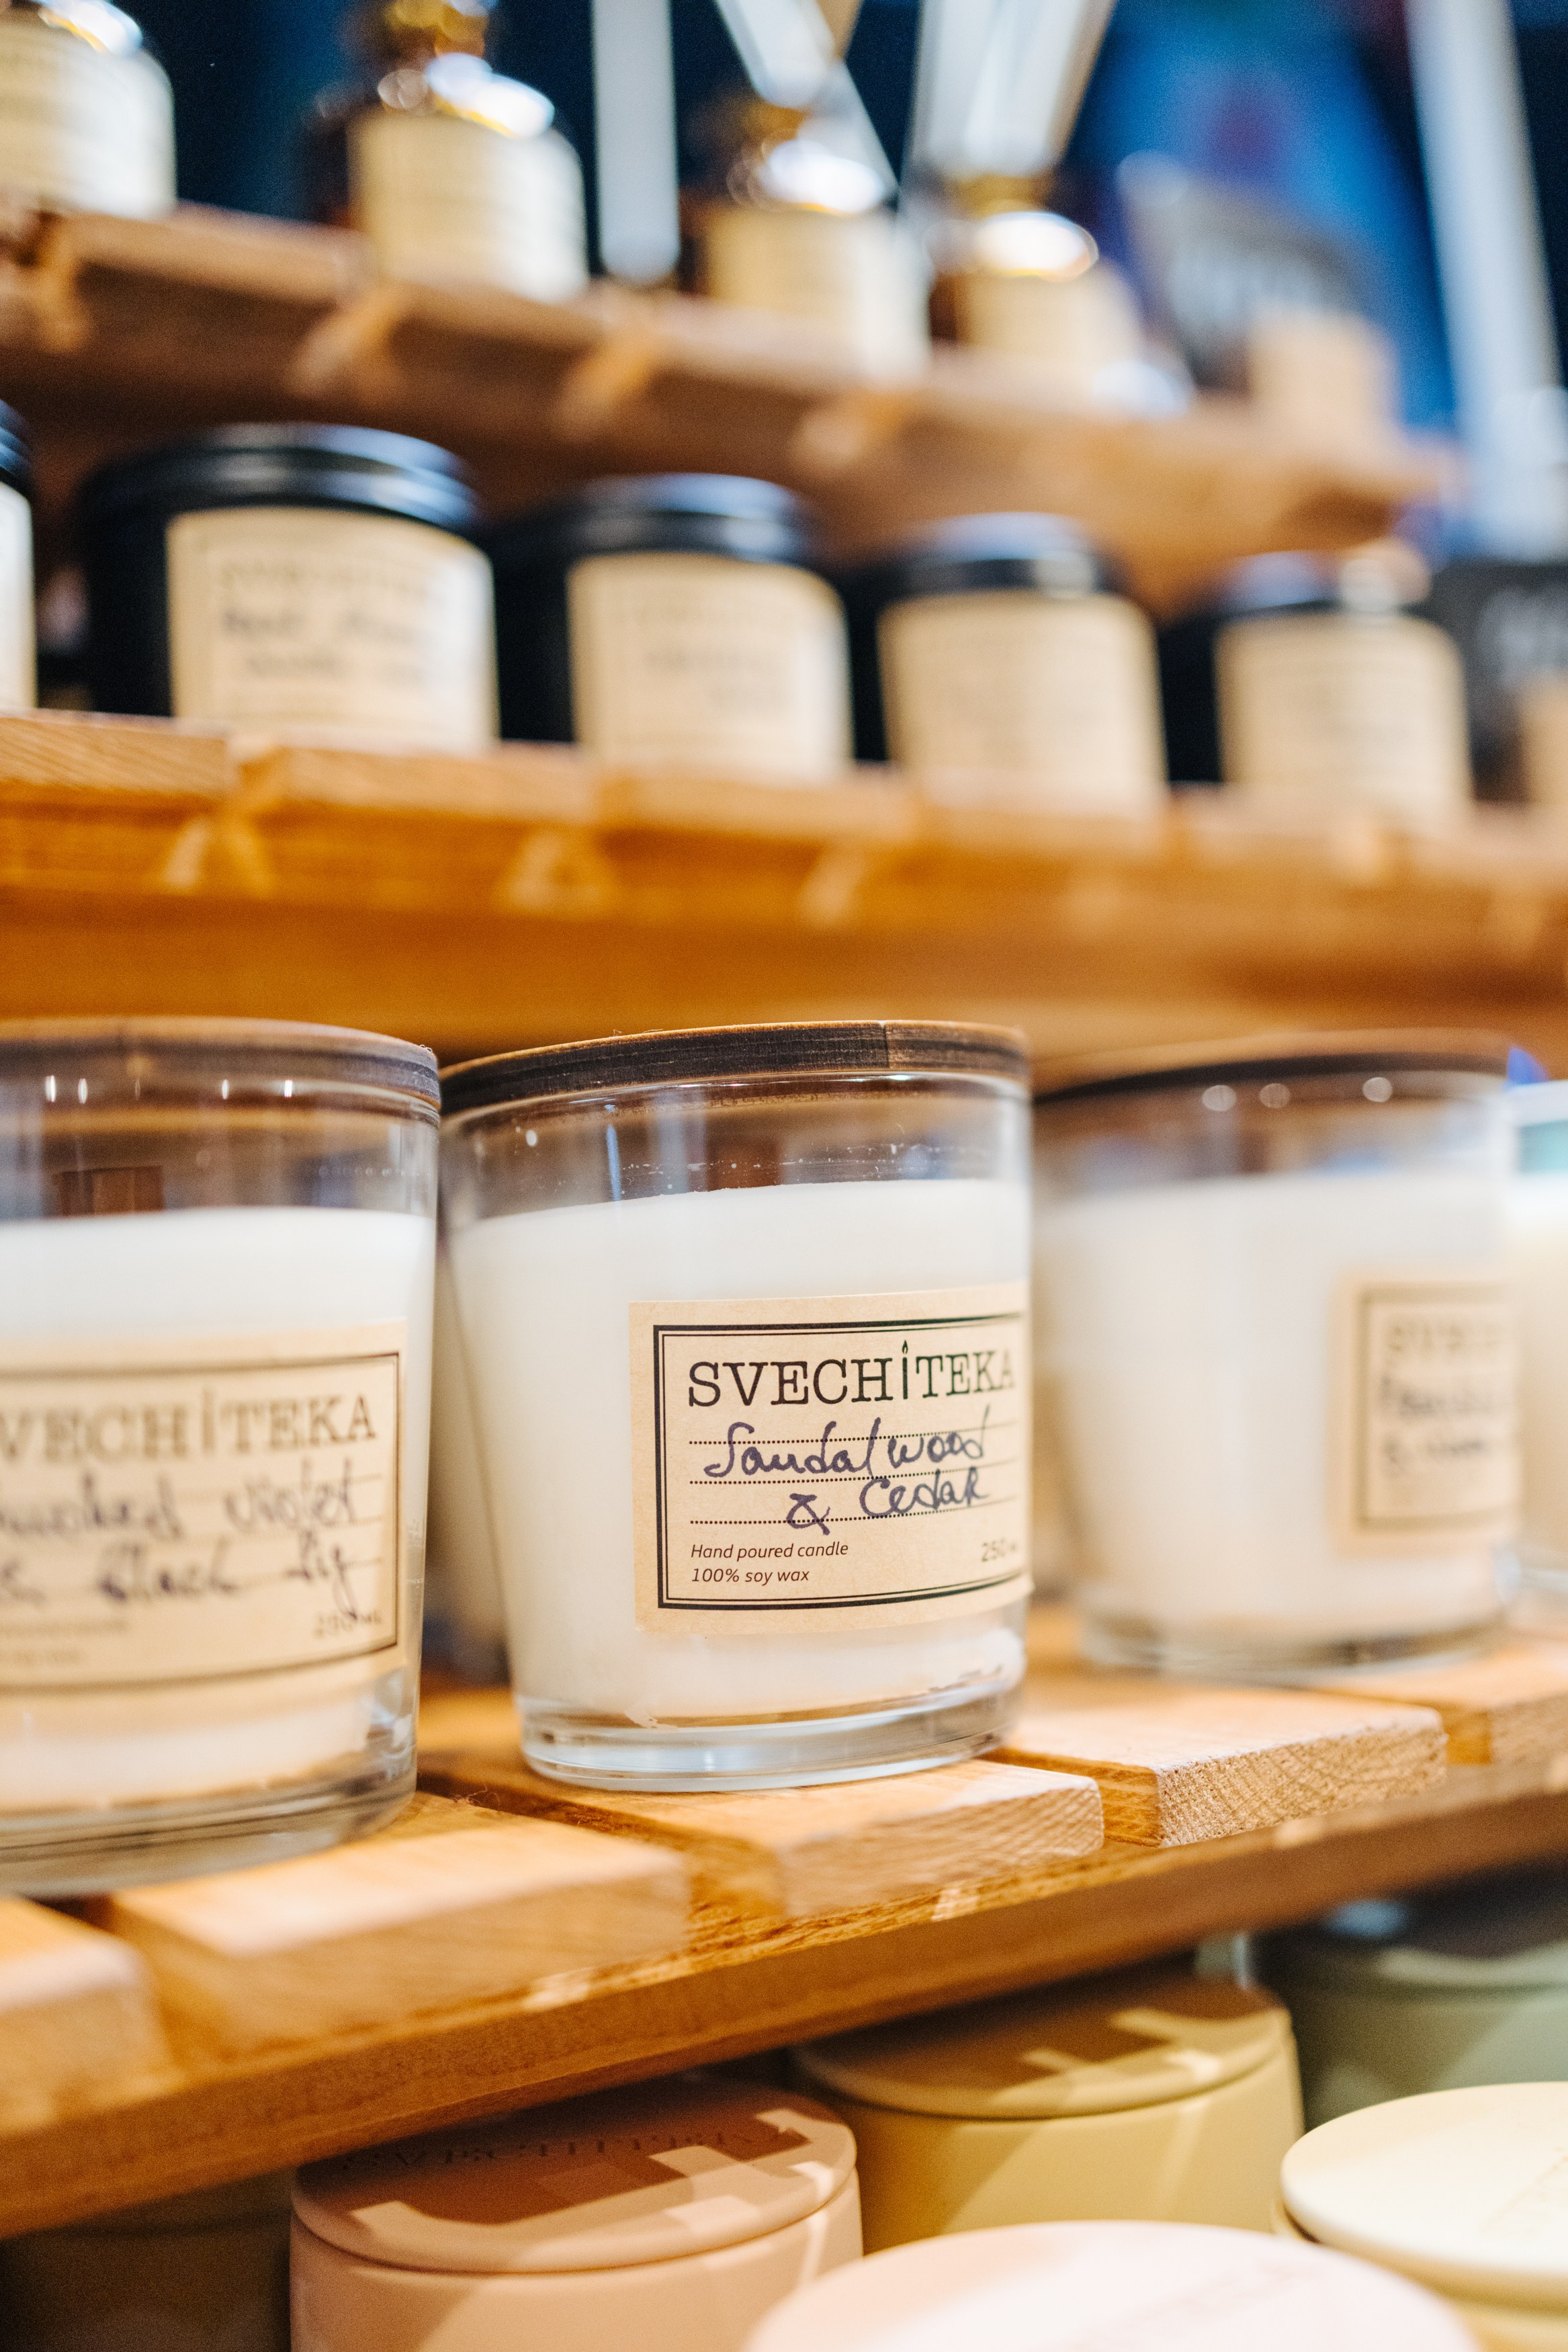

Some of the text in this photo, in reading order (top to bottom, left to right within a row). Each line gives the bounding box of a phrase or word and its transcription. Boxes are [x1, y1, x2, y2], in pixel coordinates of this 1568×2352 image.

[785, 1493, 830, 1536] &
[691, 1541, 848, 1562] Hand poured candle
[691, 1568, 810, 1586] 100% soy wax
